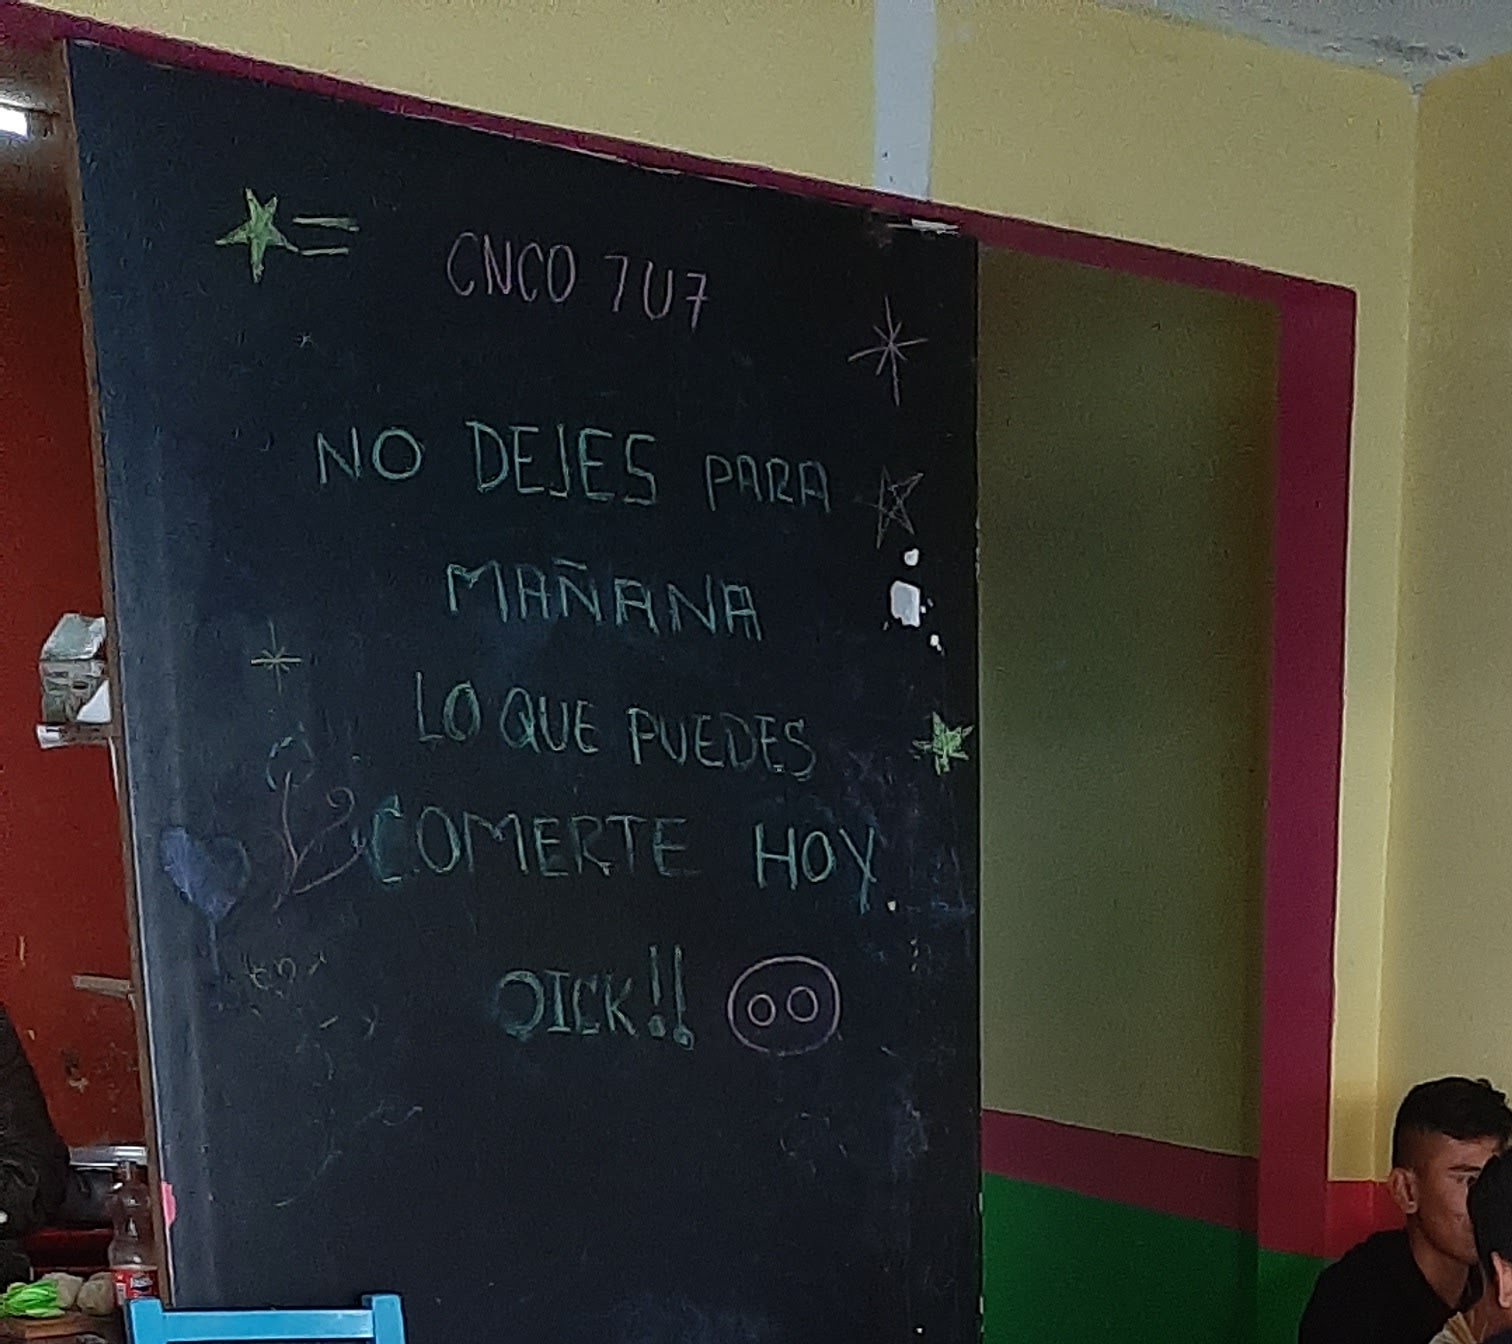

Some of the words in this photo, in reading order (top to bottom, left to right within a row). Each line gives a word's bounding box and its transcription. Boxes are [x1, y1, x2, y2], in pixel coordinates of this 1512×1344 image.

[447, 231, 576, 303] CNCO
[316, 426, 425, 484] NO
[465, 420, 658, 505] DEJES
[705, 453, 831, 513] PARA
[445, 557, 763, 642] MAÑANA
[415, 671, 482, 743] LO
[500, 687, 600, 754] QUE
[627, 705, 817, 781] PUEDES
[371, 796, 690, 888] COMERTE
[753, 820, 878, 917] HOY
